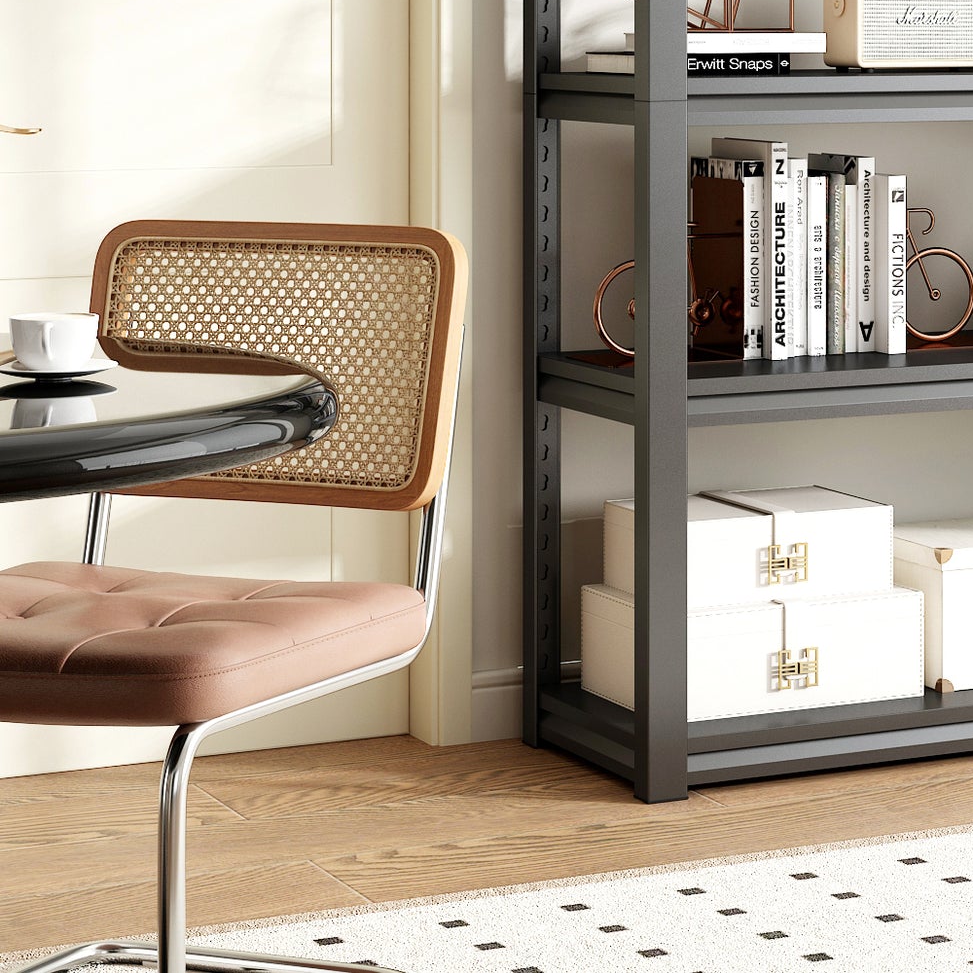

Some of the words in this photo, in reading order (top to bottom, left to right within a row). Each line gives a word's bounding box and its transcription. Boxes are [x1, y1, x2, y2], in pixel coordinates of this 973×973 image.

[687, 58, 725, 70] Erwitt
[729, 58, 773, 71] Snaps
[863, 169, 871, 238] Architecture
[750, 210, 760, 253] DESIGN
[863, 242, 871, 262] and
[750, 257, 760, 308] FASHION
[775, 202, 786, 347] ARCHITECTURE
[863, 265, 871, 302] design
[892, 234, 904, 296] FICTIONS
